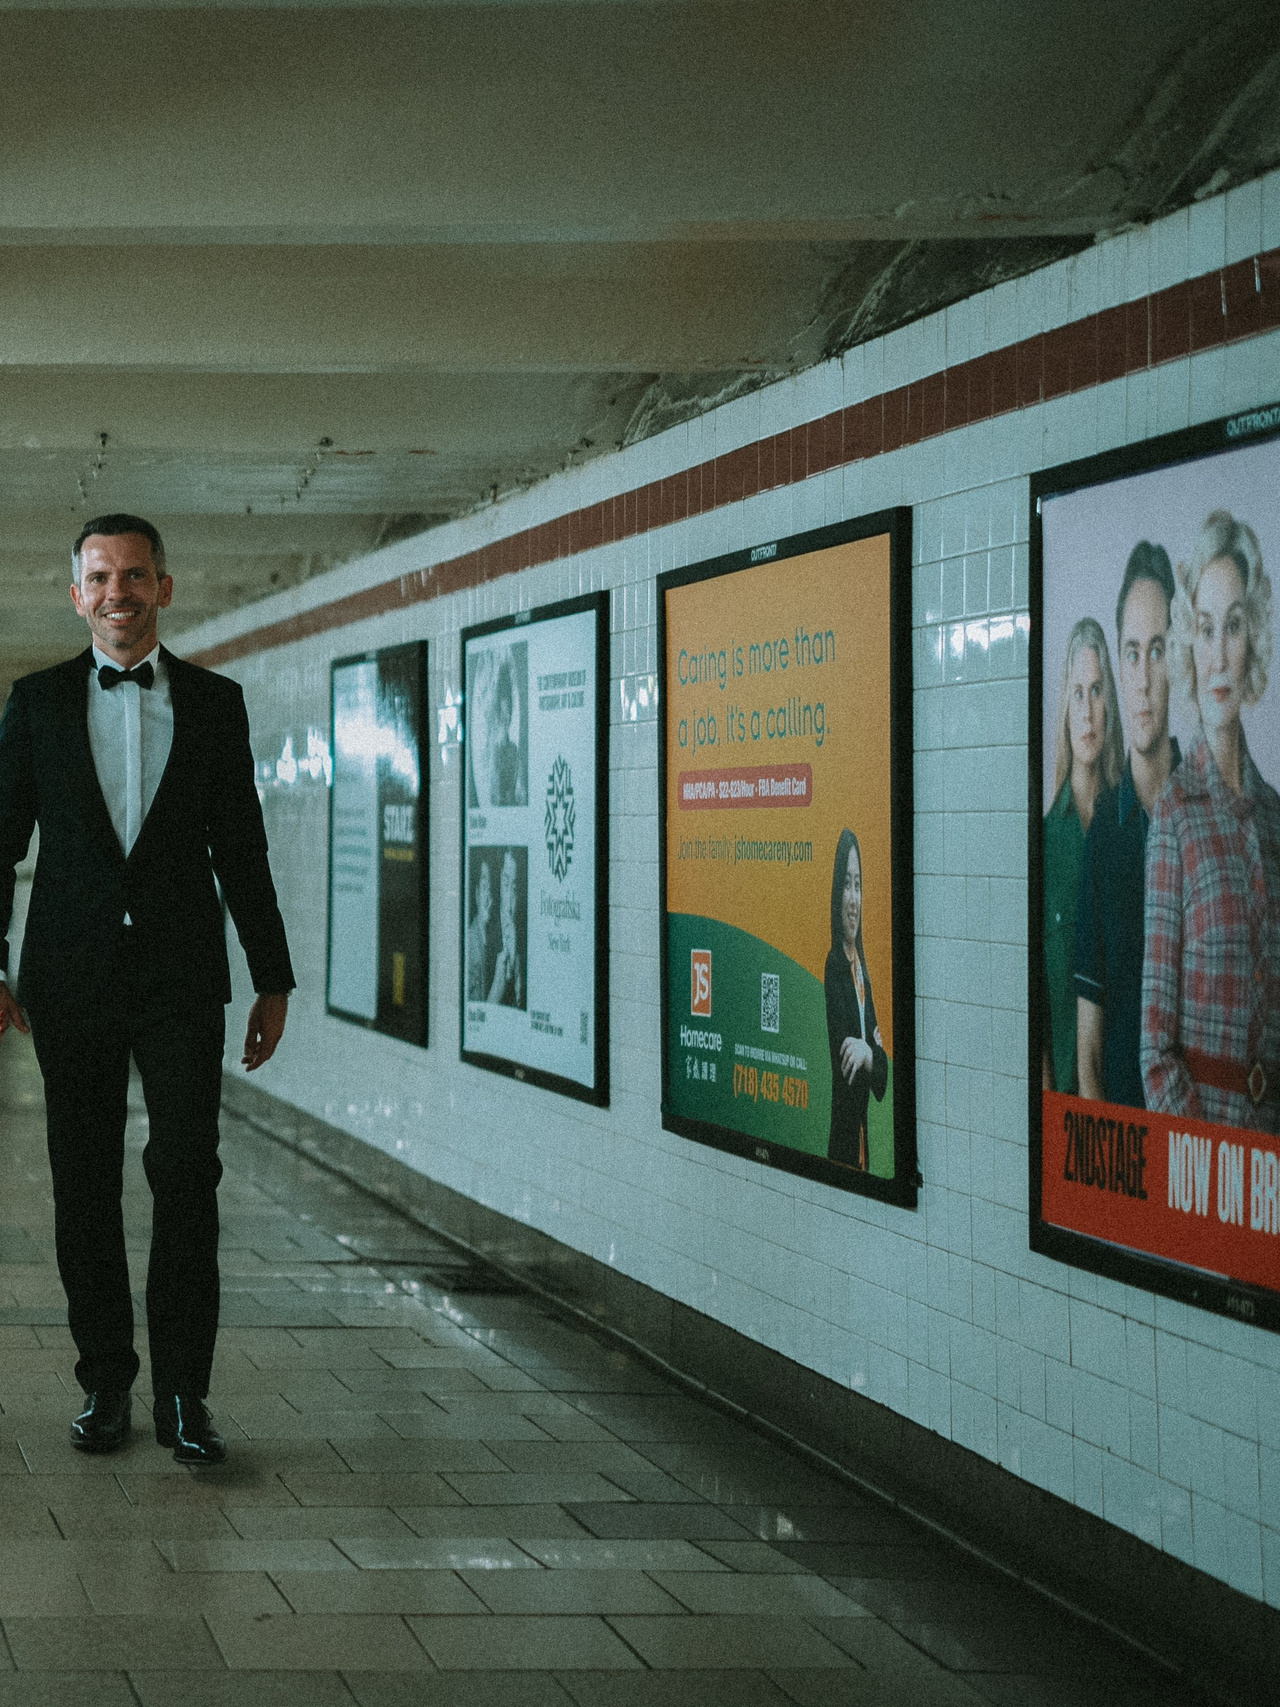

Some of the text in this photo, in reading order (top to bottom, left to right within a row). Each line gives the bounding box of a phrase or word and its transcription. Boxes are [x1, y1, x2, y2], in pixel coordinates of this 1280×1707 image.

[678, 626, 836, 691] Caring is more than
[678, 718, 688, 748] a
[692, 706, 720, 757] job,
[750, 710, 760, 741] a
[766, 696, 830, 748] calling.
[792, 776, 807, 796] Card
[679, 836, 692, 860] Join
[695, 836, 706, 860] the
[734, 834, 813, 866] jshomecareny.com
[694, 962, 709, 1006] JS
[680, 1024, 722, 1052] Homecare
[734, 1062, 809, 1110] (718) 435 4570
[1168, 1130, 1280, 1236] NOW ON BR
